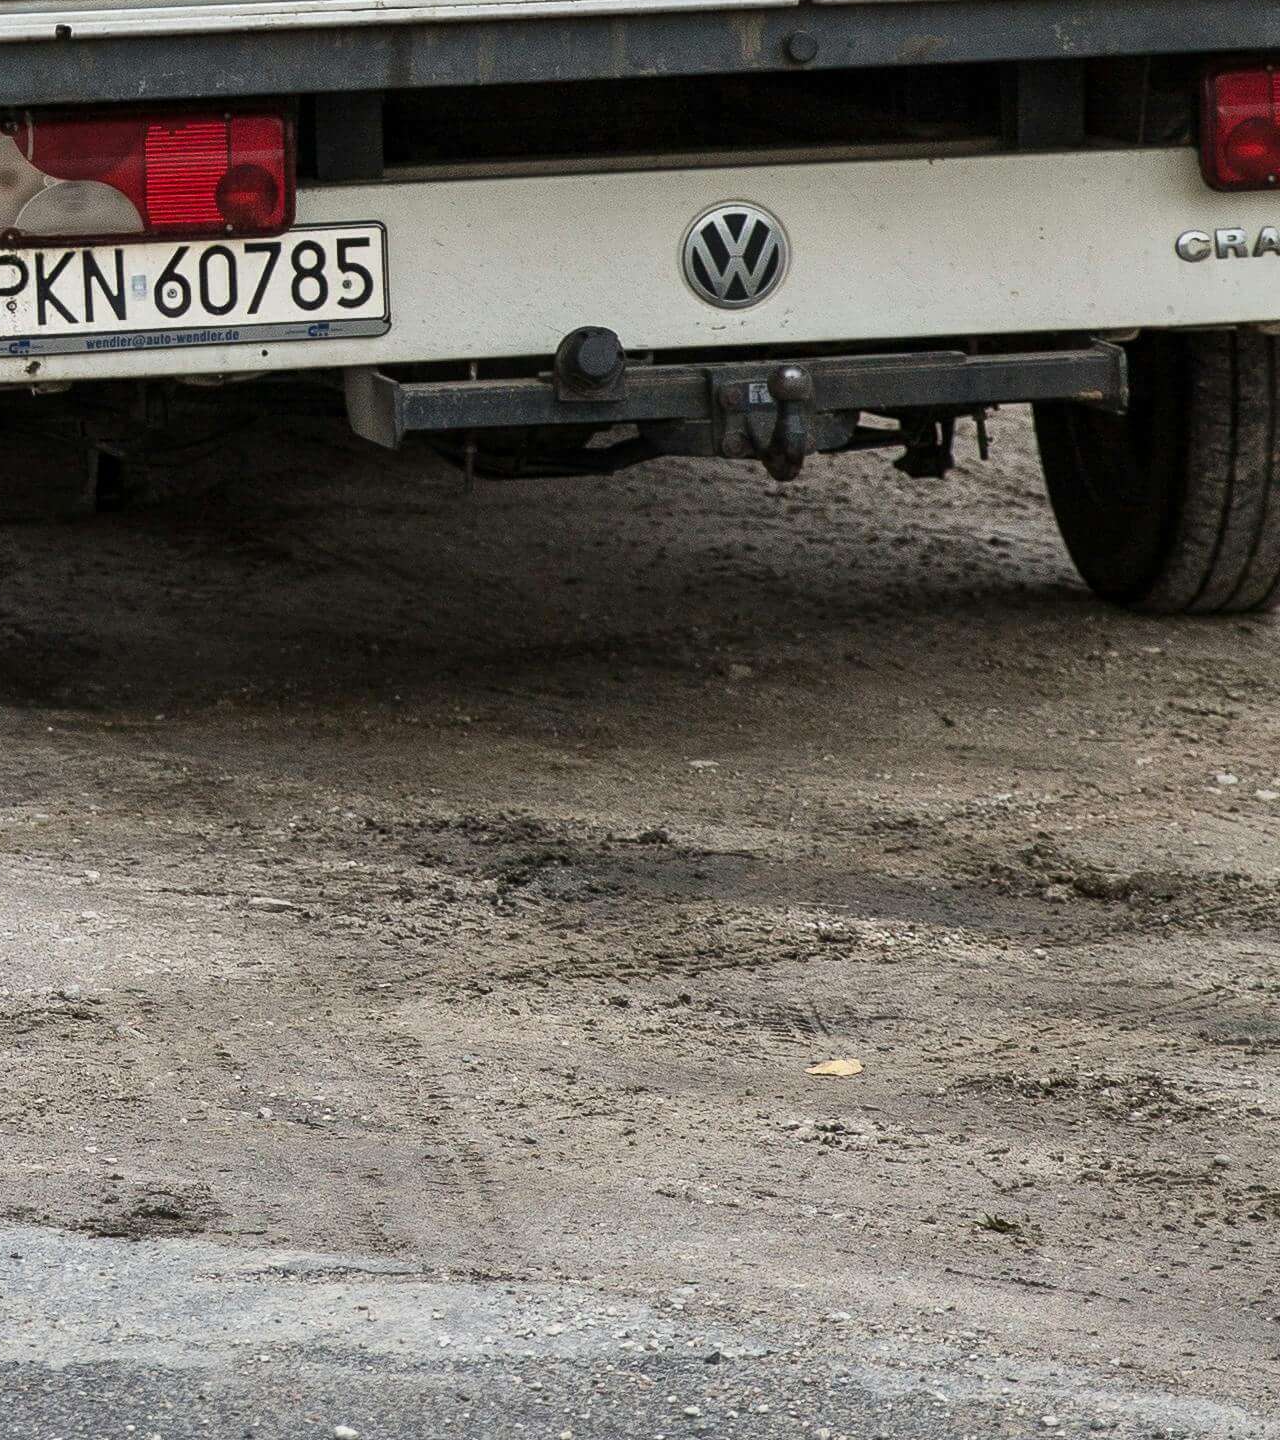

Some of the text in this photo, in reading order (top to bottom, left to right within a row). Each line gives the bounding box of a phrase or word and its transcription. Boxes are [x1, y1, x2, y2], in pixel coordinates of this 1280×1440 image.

[154, 237, 373, 318] 60785
[685, 206, 784, 305] VW
[1175, 226, 1280, 262] CRA
